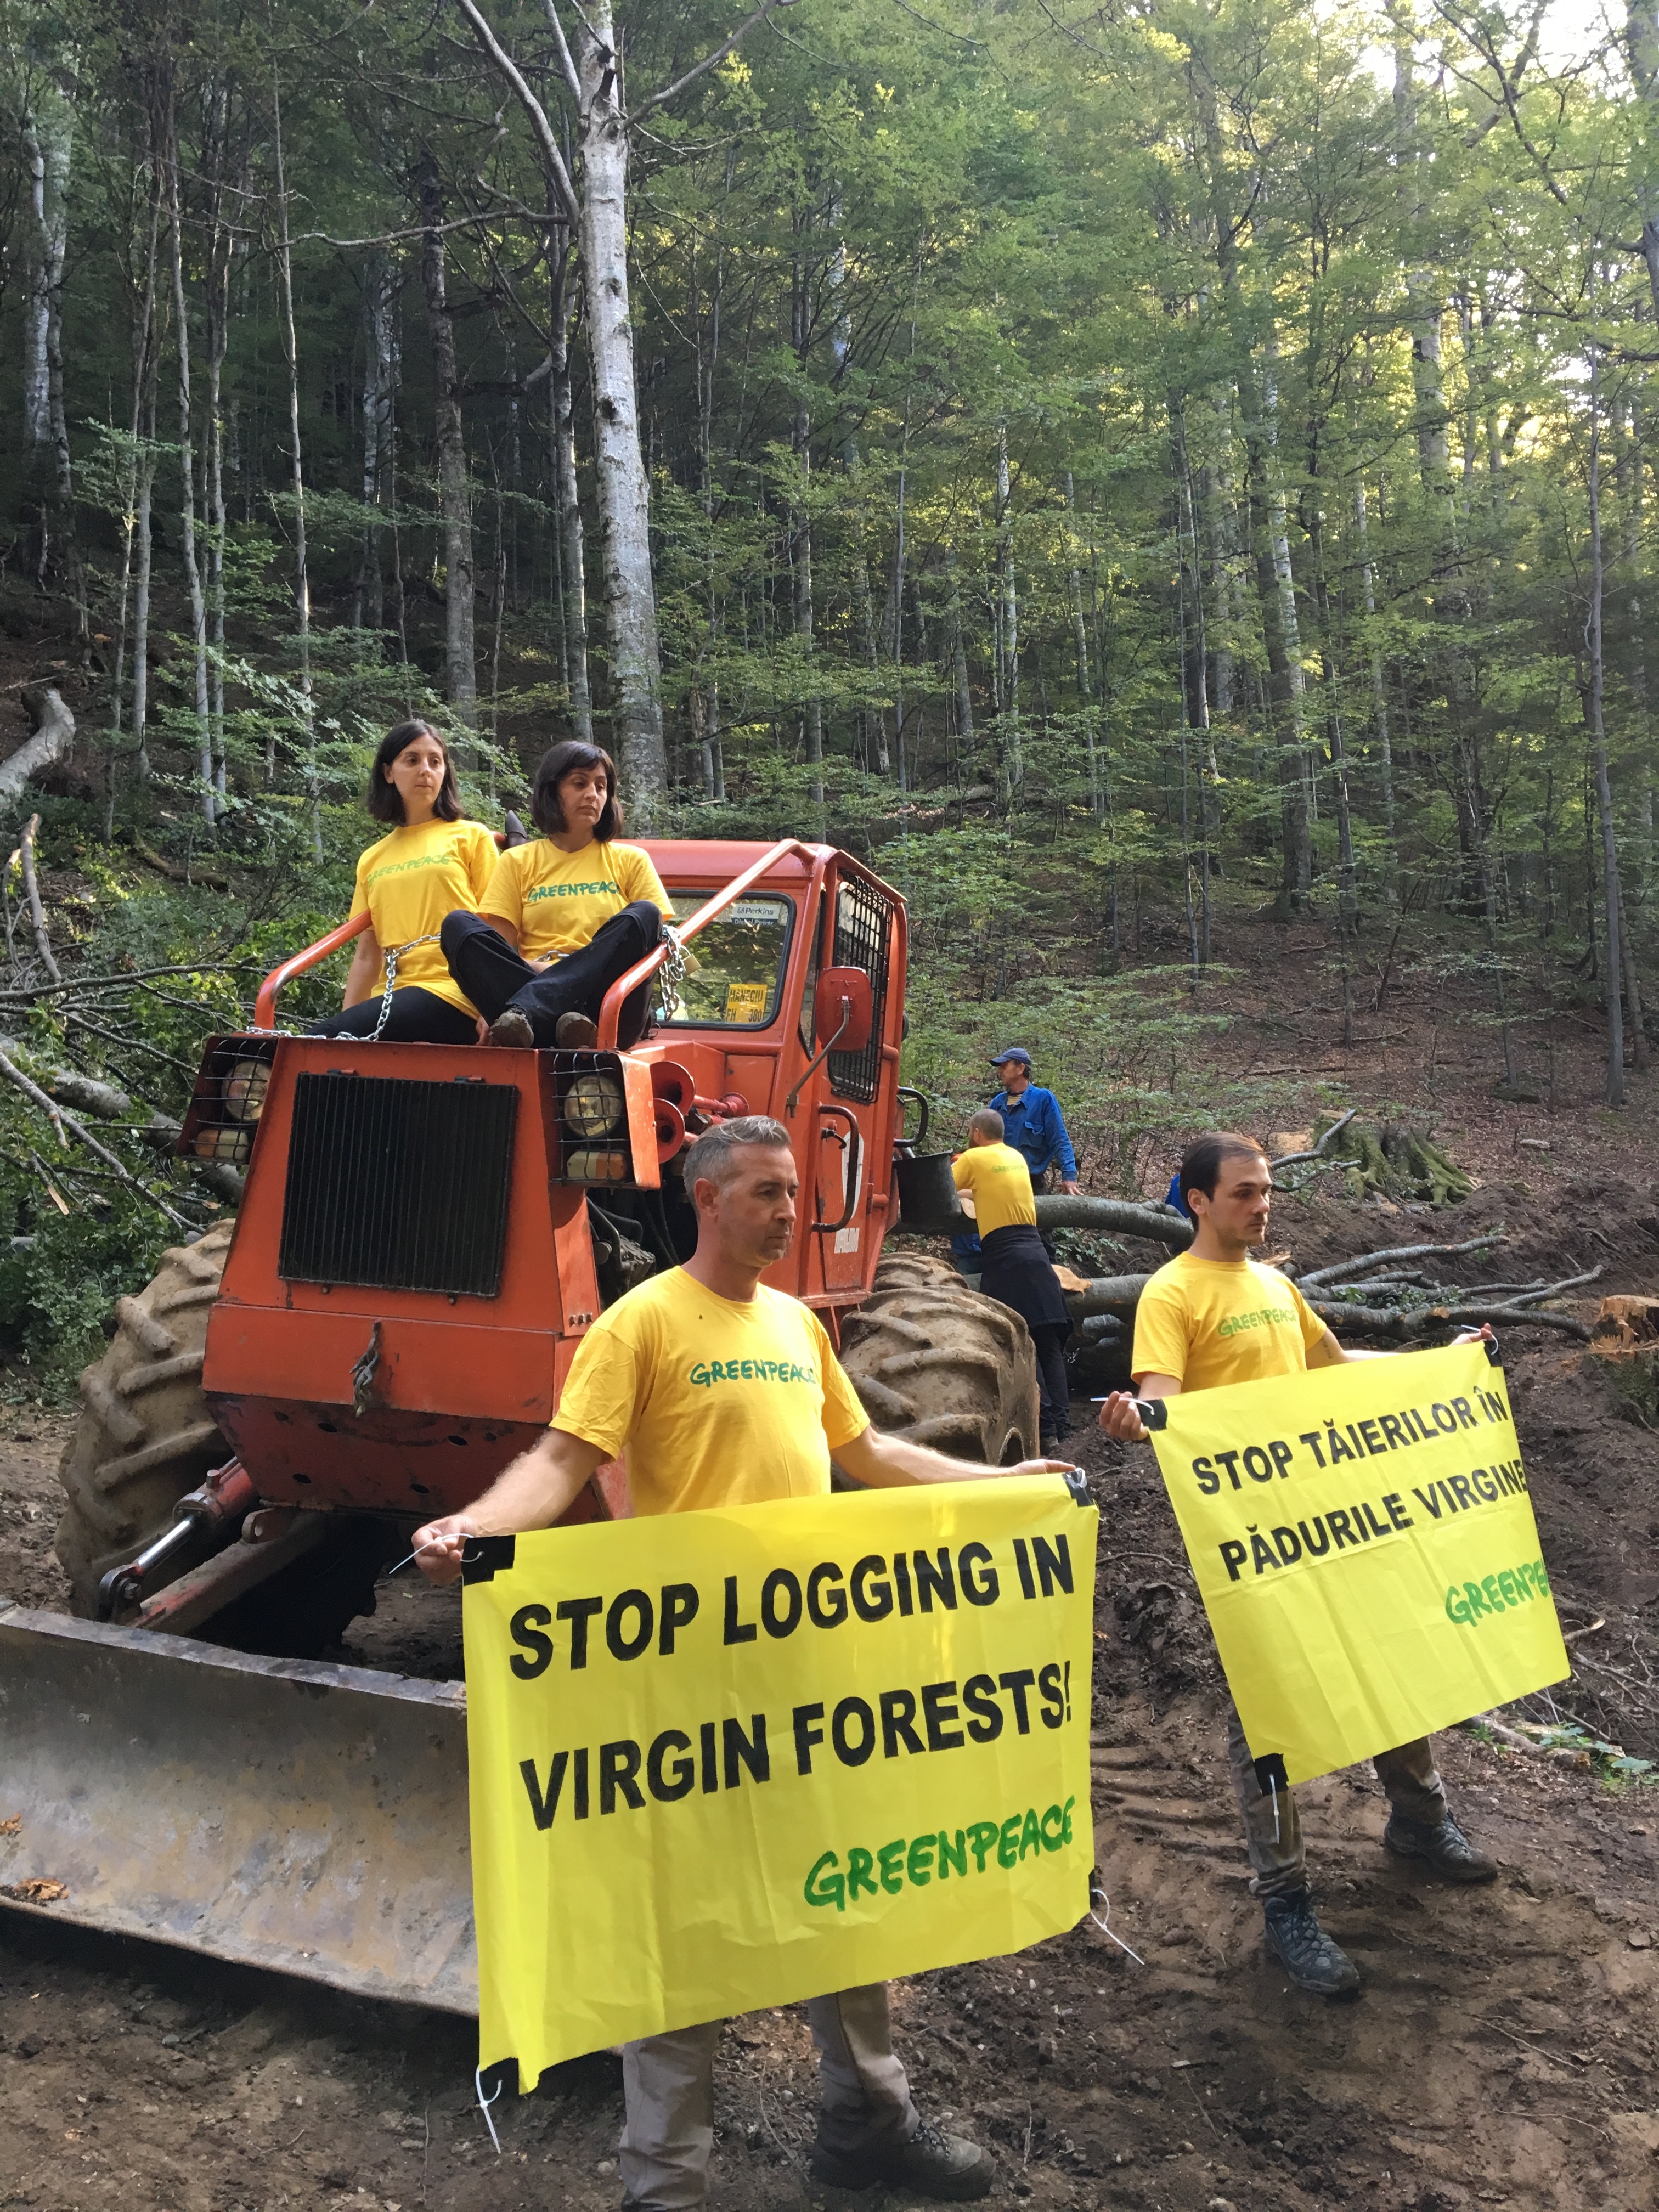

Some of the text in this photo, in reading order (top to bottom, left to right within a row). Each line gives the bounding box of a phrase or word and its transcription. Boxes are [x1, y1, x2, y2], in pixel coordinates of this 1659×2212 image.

[527, 881, 619, 902] GREENPEAC
[746, 907, 774, 915] Perkins
[748, 1009, 762, 1022] 380
[1217, 1308, 1297, 1336] GREENPEACE
[1193, 1385, 1509, 1495] STOP TĂIERILOR ÎN
[1219, 1459, 1528, 1582] PĂDURILE VIRGINE
[509, 1534, 1074, 1680] STOP LOGGING IN
[519, 1660, 1071, 1831] VIRGIN FORESTS!
[804, 1795, 1075, 1912] GREENPEACE
